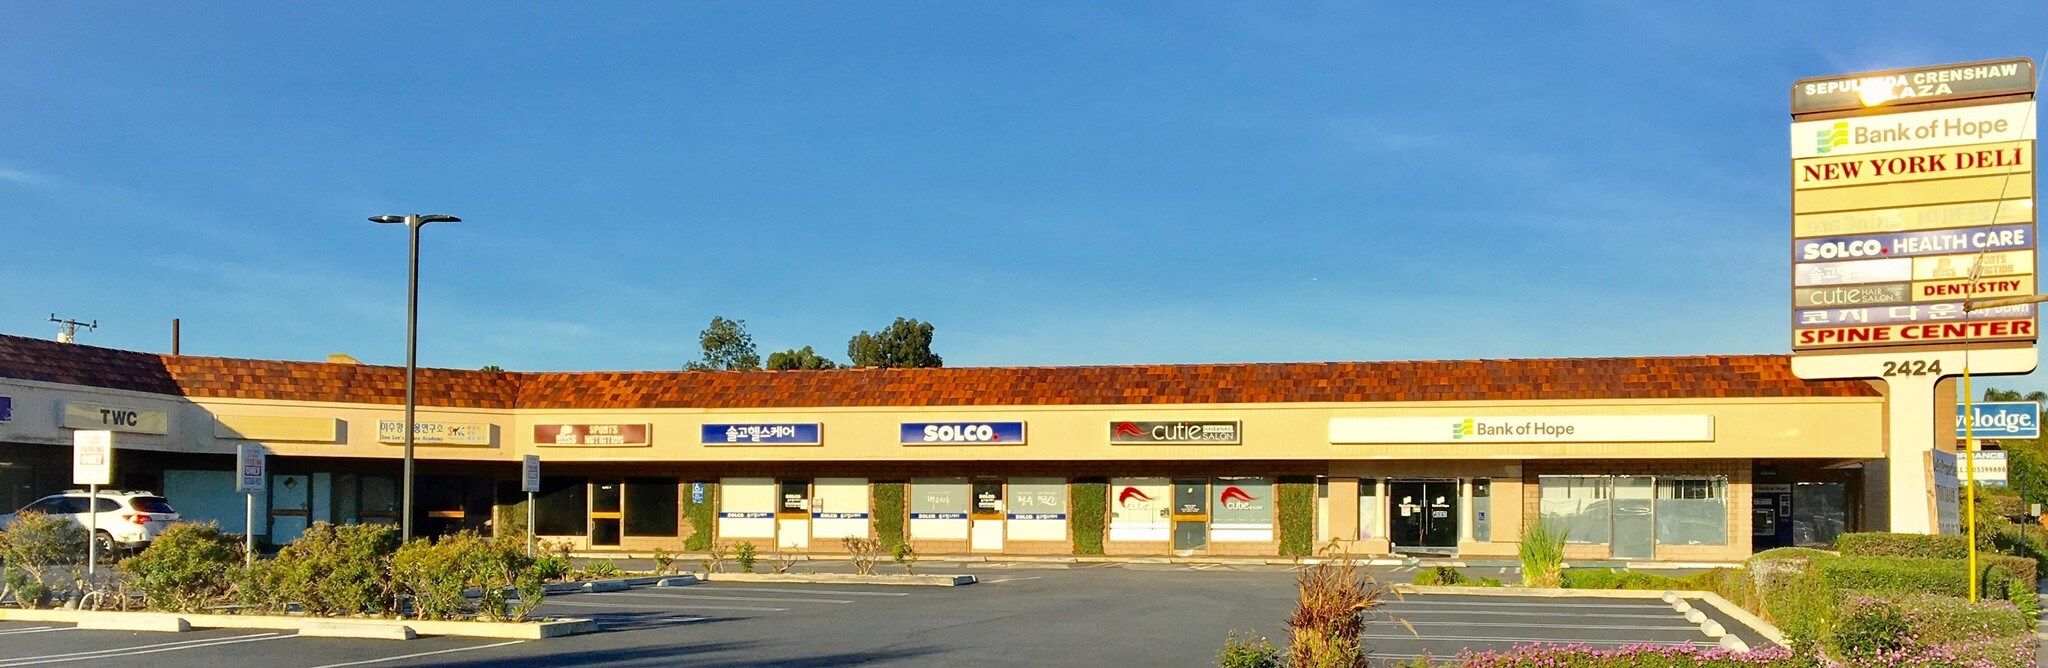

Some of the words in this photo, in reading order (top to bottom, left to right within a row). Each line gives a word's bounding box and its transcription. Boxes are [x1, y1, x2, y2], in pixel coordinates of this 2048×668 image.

[1805, 75, 1909, 95] SEPULDA
[1914, 64, 2018, 85] CRENSHAW
[1872, 83, 1953, 101] LAZA
[1855, 123, 1911, 144] Bank
[1915, 121, 1938, 138] of
[1944, 118, 2008, 139] Hope
[1803, 161, 1862, 182] NEW
[1870, 155, 1946, 176] YORK
[1956, 148, 2023, 170] DELI
[1893, 233, 1967, 254] HEALTH
[1972, 229, 2025, 249] CARE
[1811, 287, 1860, 305] cutie
[1862, 288, 1882, 296] HAIR
[1924, 280, 2021, 296] DENTISTRY
[1862, 294, 1894, 303] SALON
[1800, 326, 1891, 344] SPINE
[1900, 320, 2032, 339] CENTER
[1883, 360, 1942, 377] 2424
[100, 409, 137, 427] TWC
[589, 425, 618, 434] SPORTS
[725, 425, 795, 442] 솔고헬스케어
[1152, 422, 1201, 440] cutie
[1203, 432, 1233, 440] SALON
[1477, 421, 1513, 436] Bank
[1516, 421, 1530, 436] of
[1534, 423, 1575, 438] Hope
[584, 435, 624, 444] NUTRITION
[1227, 502, 1249, 510] cutie
